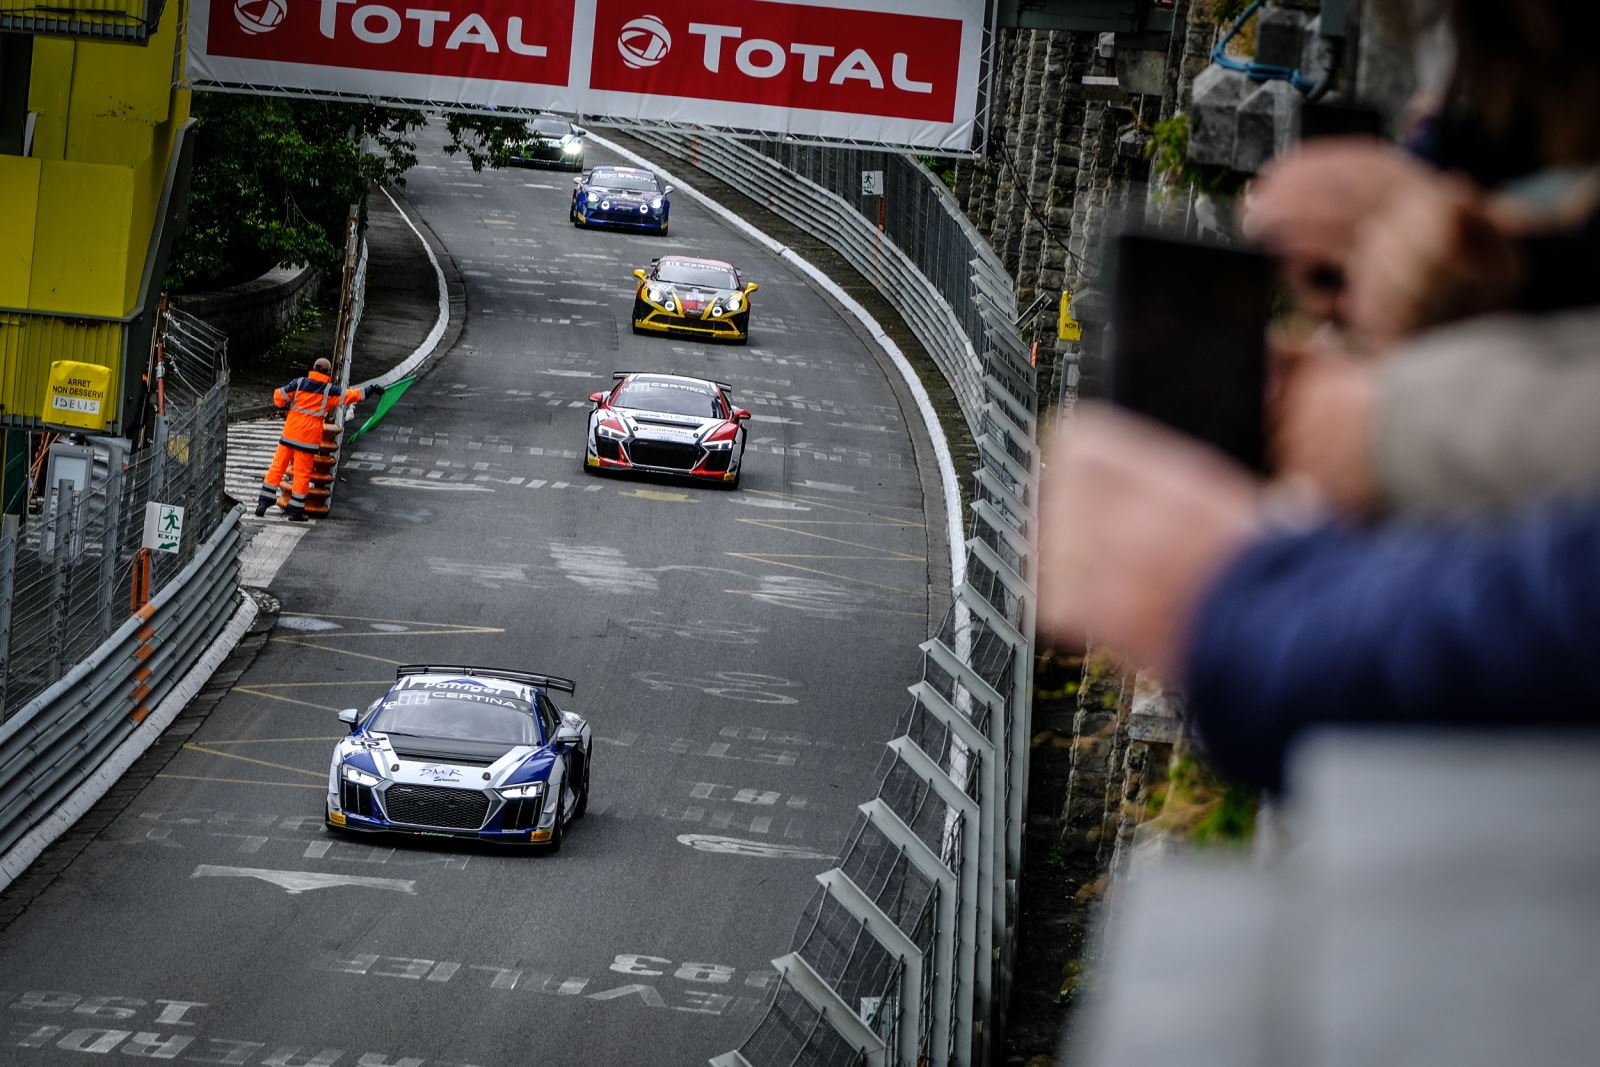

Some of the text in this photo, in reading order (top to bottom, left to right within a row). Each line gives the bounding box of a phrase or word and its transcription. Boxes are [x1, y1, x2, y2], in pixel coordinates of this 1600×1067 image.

[317, 0, 548, 58] TOTAL
[688, 22, 933, 95] TOTAL
[67, 378, 92, 388] ARRET
[651, 382, 708, 395] CERTINA
[52, 385, 104, 399] NON DESSERVI
[55, 396, 96, 412] IDELIS
[157, 533, 180, 541] EXIT
[431, 691, 517, 709] CERTINA
